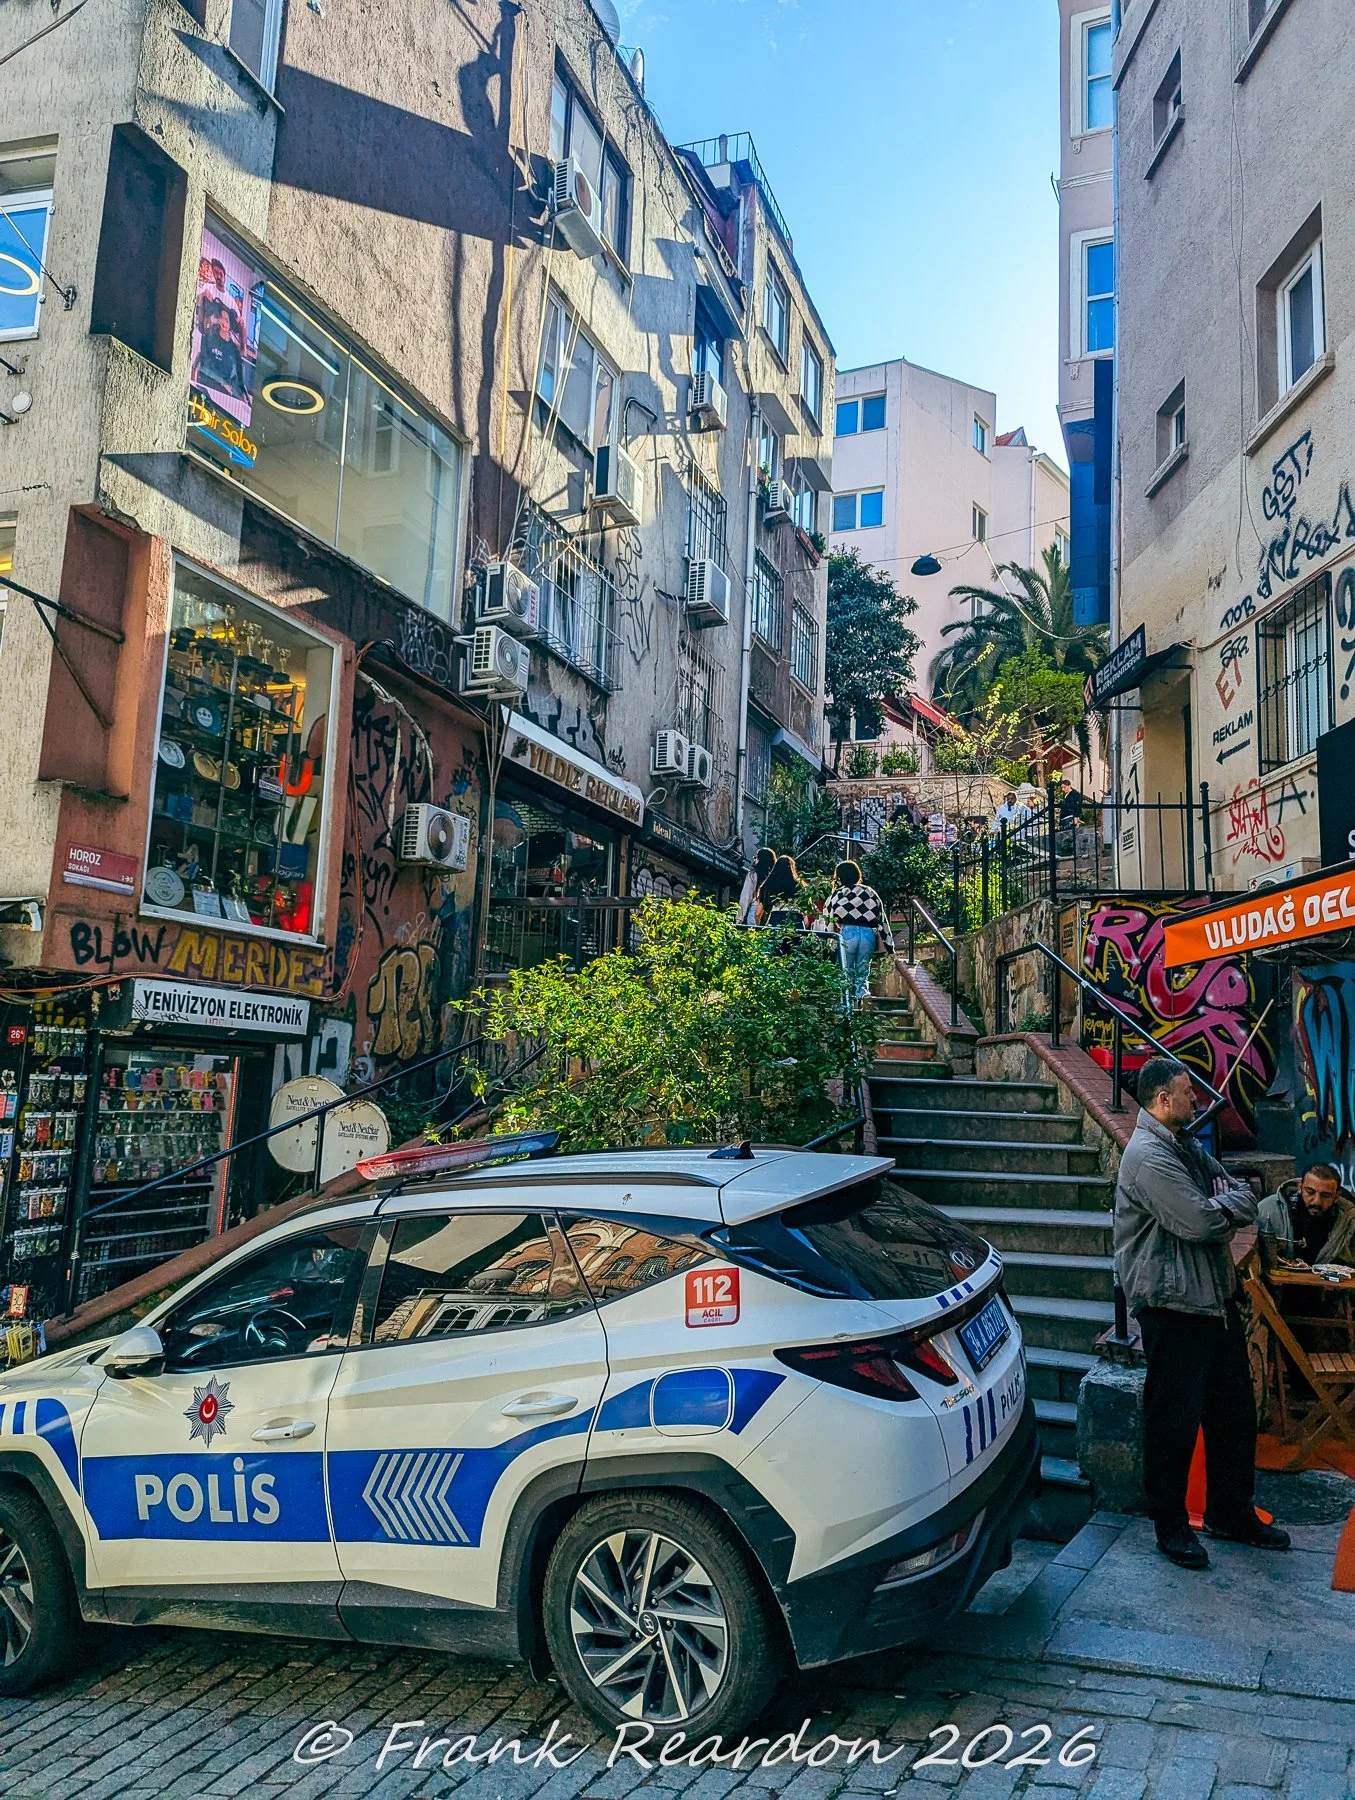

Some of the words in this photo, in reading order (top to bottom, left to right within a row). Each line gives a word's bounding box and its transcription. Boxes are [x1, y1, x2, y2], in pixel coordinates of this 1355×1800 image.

[190, 395, 221, 430] Hair
[221, 420, 258, 459] Salon
[1095, 632, 1142, 688] REKLAM
[1215, 656, 1243, 711] ET
[1212, 709, 1254, 747] REKLAM
[529, 742, 584, 792] YILDIZ
[69, 847, 102, 866] HOROZ
[1204, 894, 1297, 950] ULUDAĞ
[143, 987, 226, 1018] YENİVİZYON
[229, 1002, 304, 1026] ELEKTRONİK
[287, 1094, 302, 1106] Next
[303, 1096, 310, 1106] &
[339, 1121, 351, 1132] Next
[351, 1122, 357, 1132] &
[357, 1123, 379, 1135] NextStar
[693, 1275, 733, 1304] 112
[702, 1308, 723, 1319] ACİL
[966, 1326, 983, 1356] 34
[976, 1320, 988, 1347] A
[135, 1456, 280, 1525] POLİS
